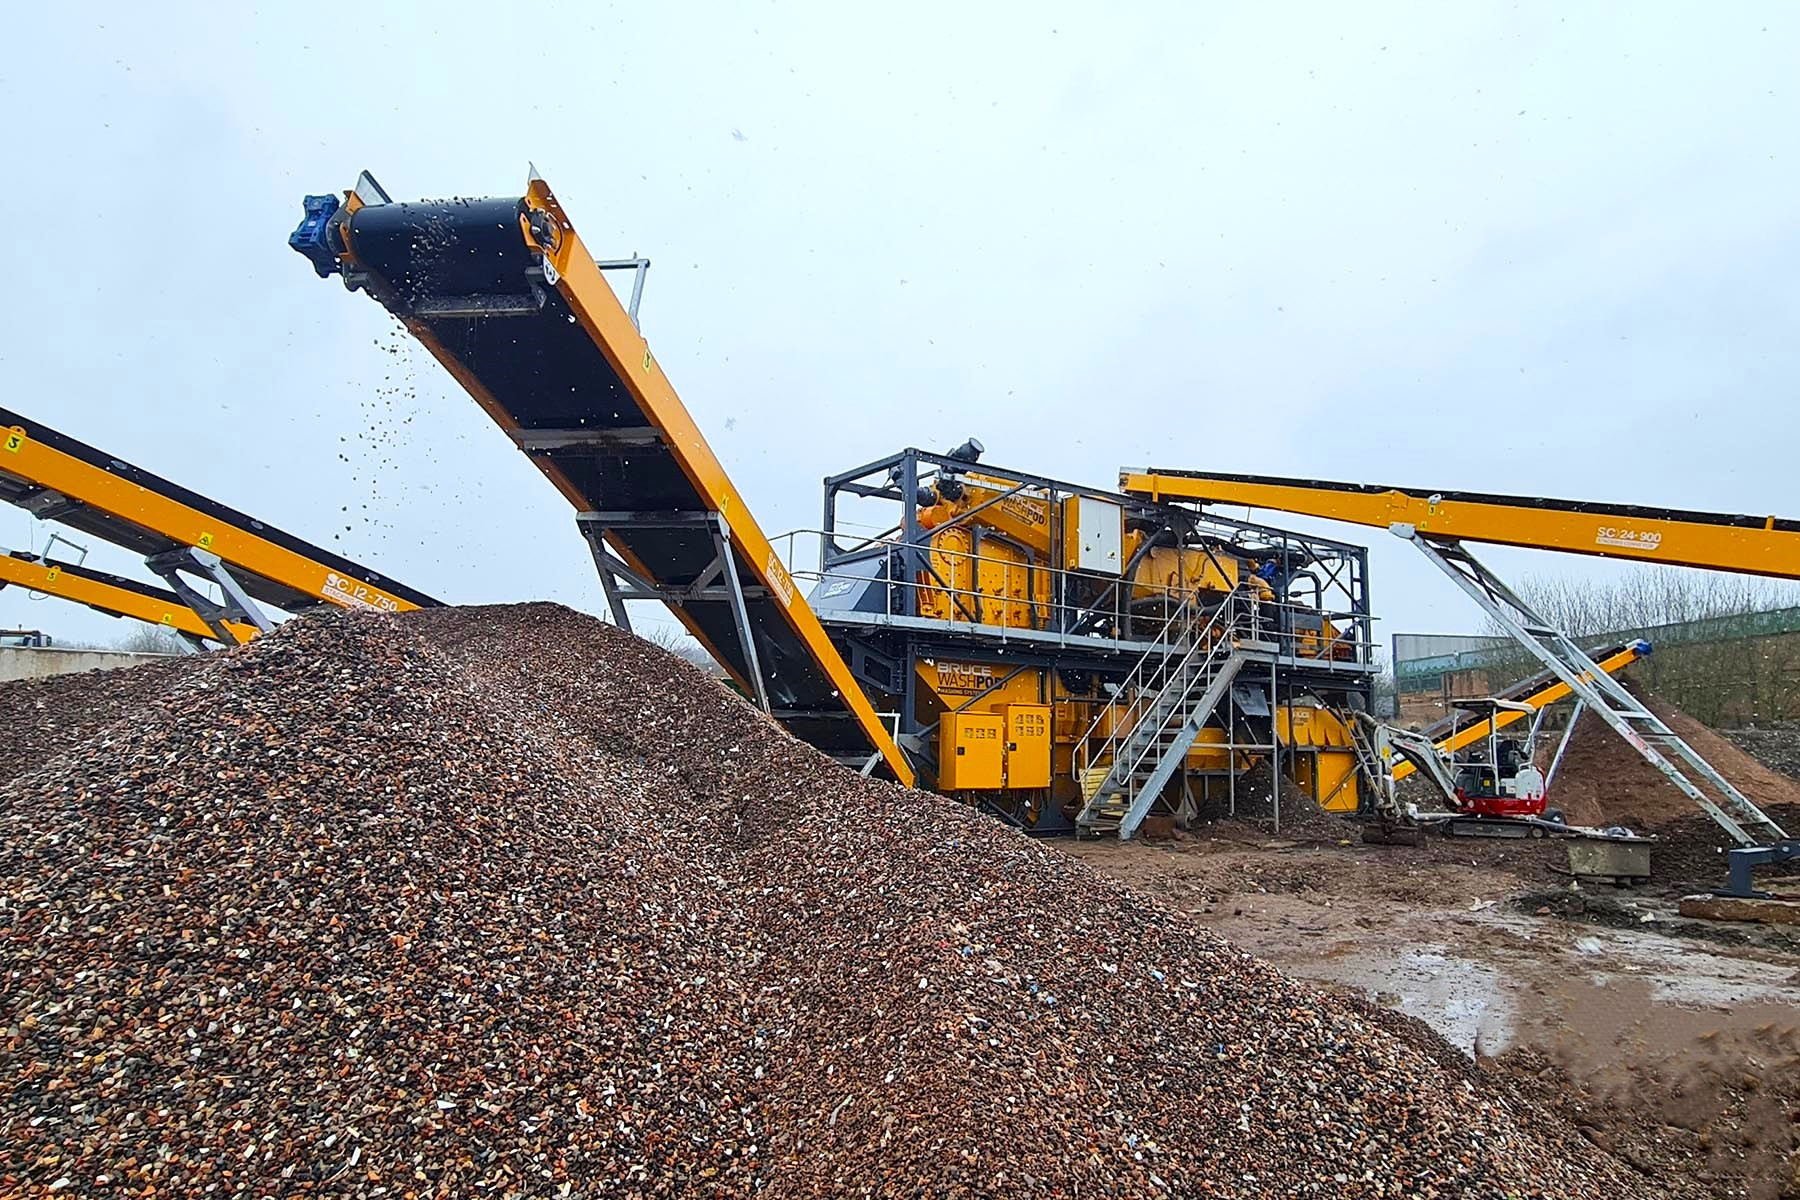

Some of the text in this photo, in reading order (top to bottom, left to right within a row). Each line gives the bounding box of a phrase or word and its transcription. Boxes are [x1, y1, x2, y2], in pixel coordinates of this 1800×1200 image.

[1003, 497, 1045, 525] WASHPOD
[1597, 527, 1616, 537] SC
[937, 662, 992, 677] BRUCE
